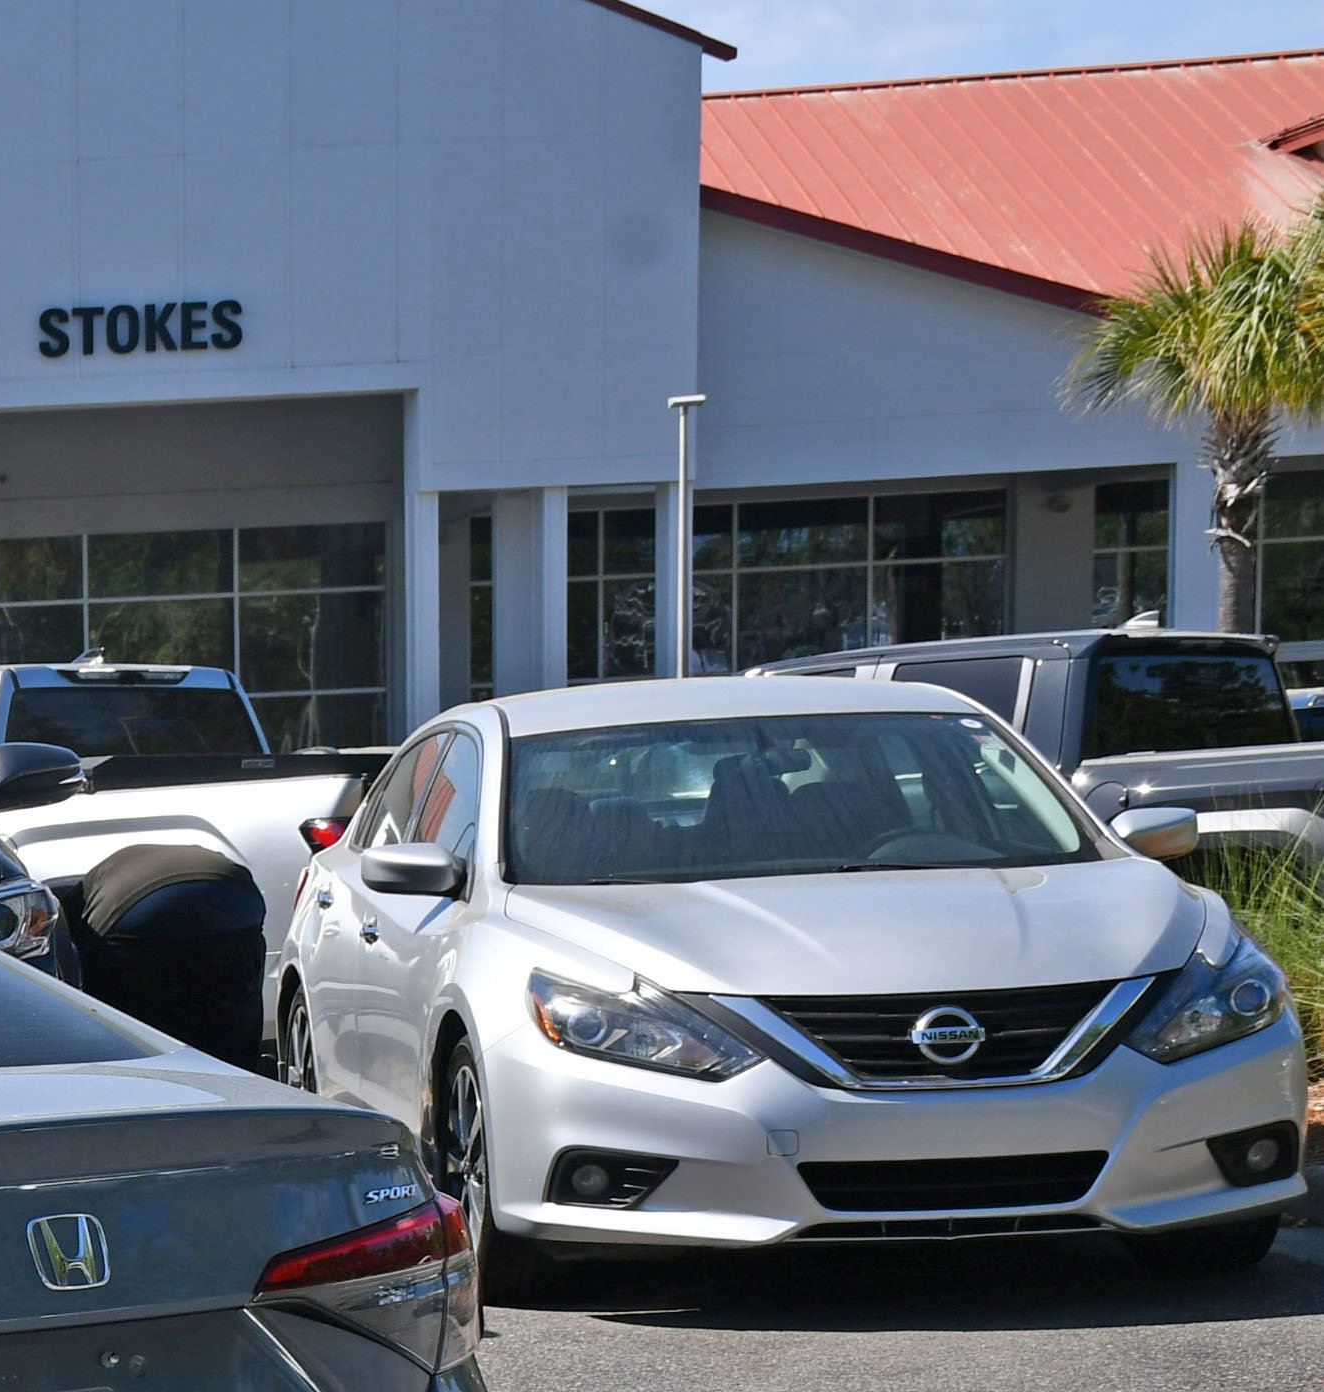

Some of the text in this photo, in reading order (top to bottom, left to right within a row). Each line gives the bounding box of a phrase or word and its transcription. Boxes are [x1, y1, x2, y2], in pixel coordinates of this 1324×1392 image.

[38, 299, 243, 358] STOKES
[921, 1030, 979, 1041] NISSAN
[365, 1183, 418, 1205] SPORT
